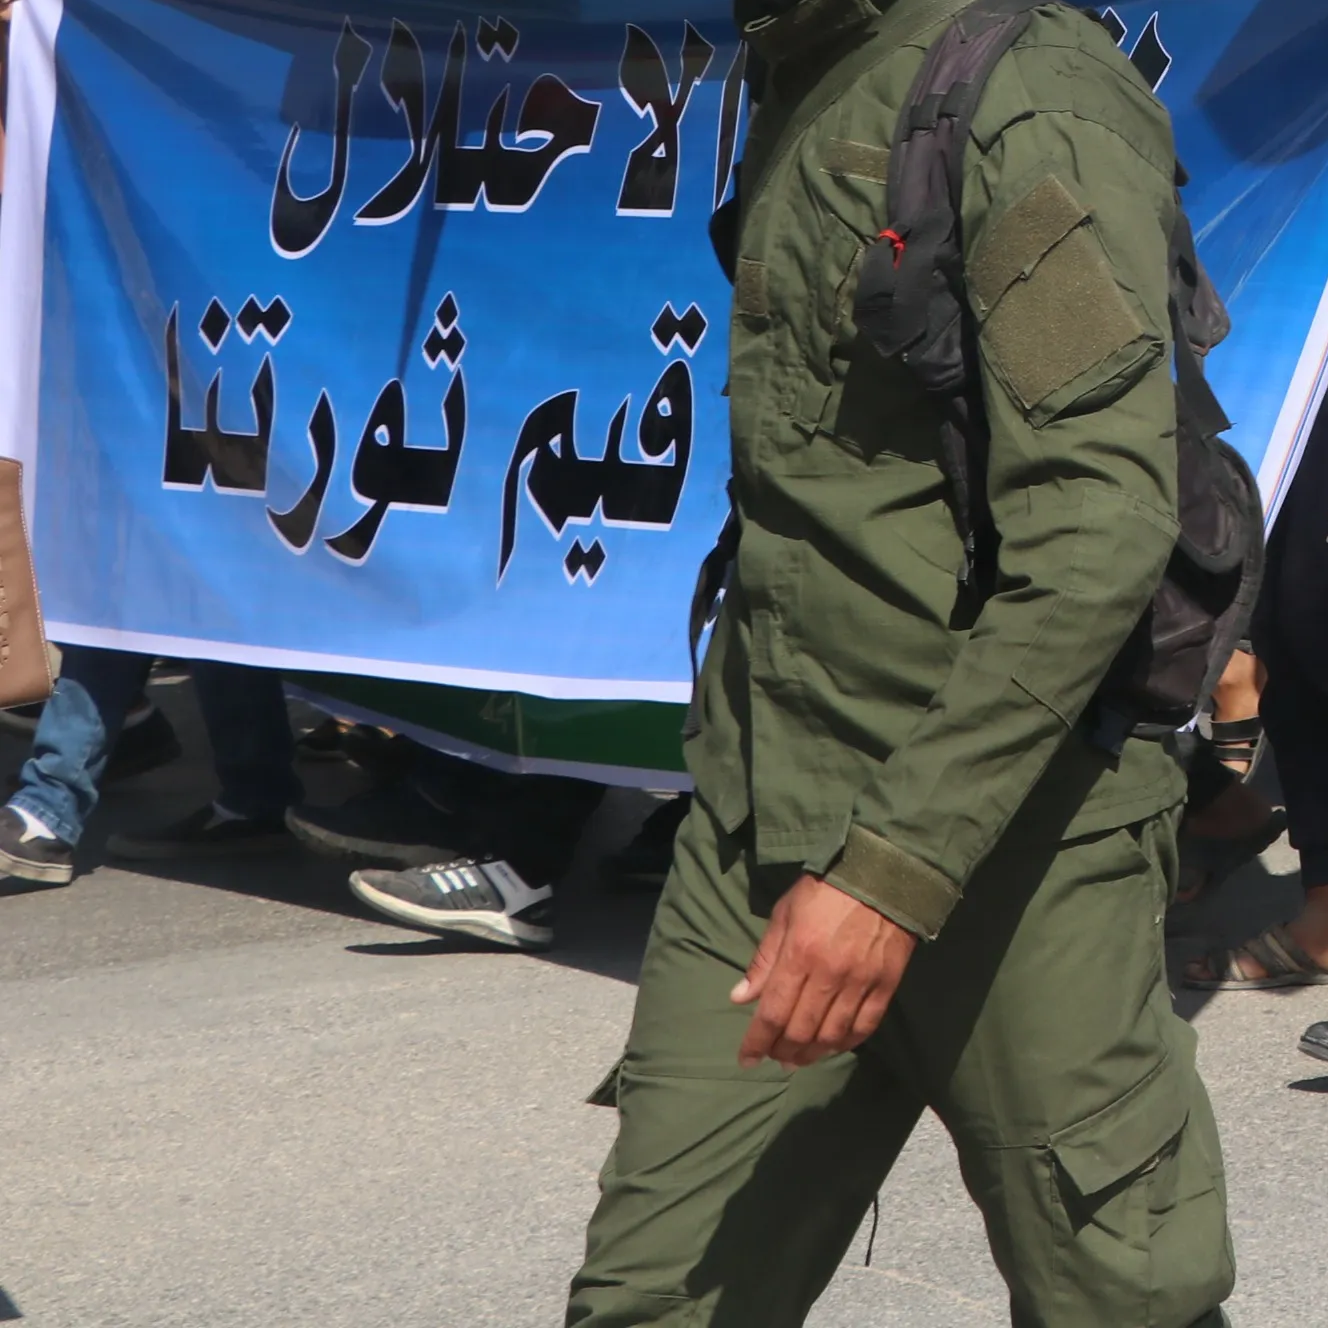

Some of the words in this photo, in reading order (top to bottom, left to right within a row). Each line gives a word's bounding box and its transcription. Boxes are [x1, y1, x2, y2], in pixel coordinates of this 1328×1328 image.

[269, 15, 747, 259] الاحتلال
[162, 291, 467, 567] ثورتنا
[496, 299, 708, 589] قيم
